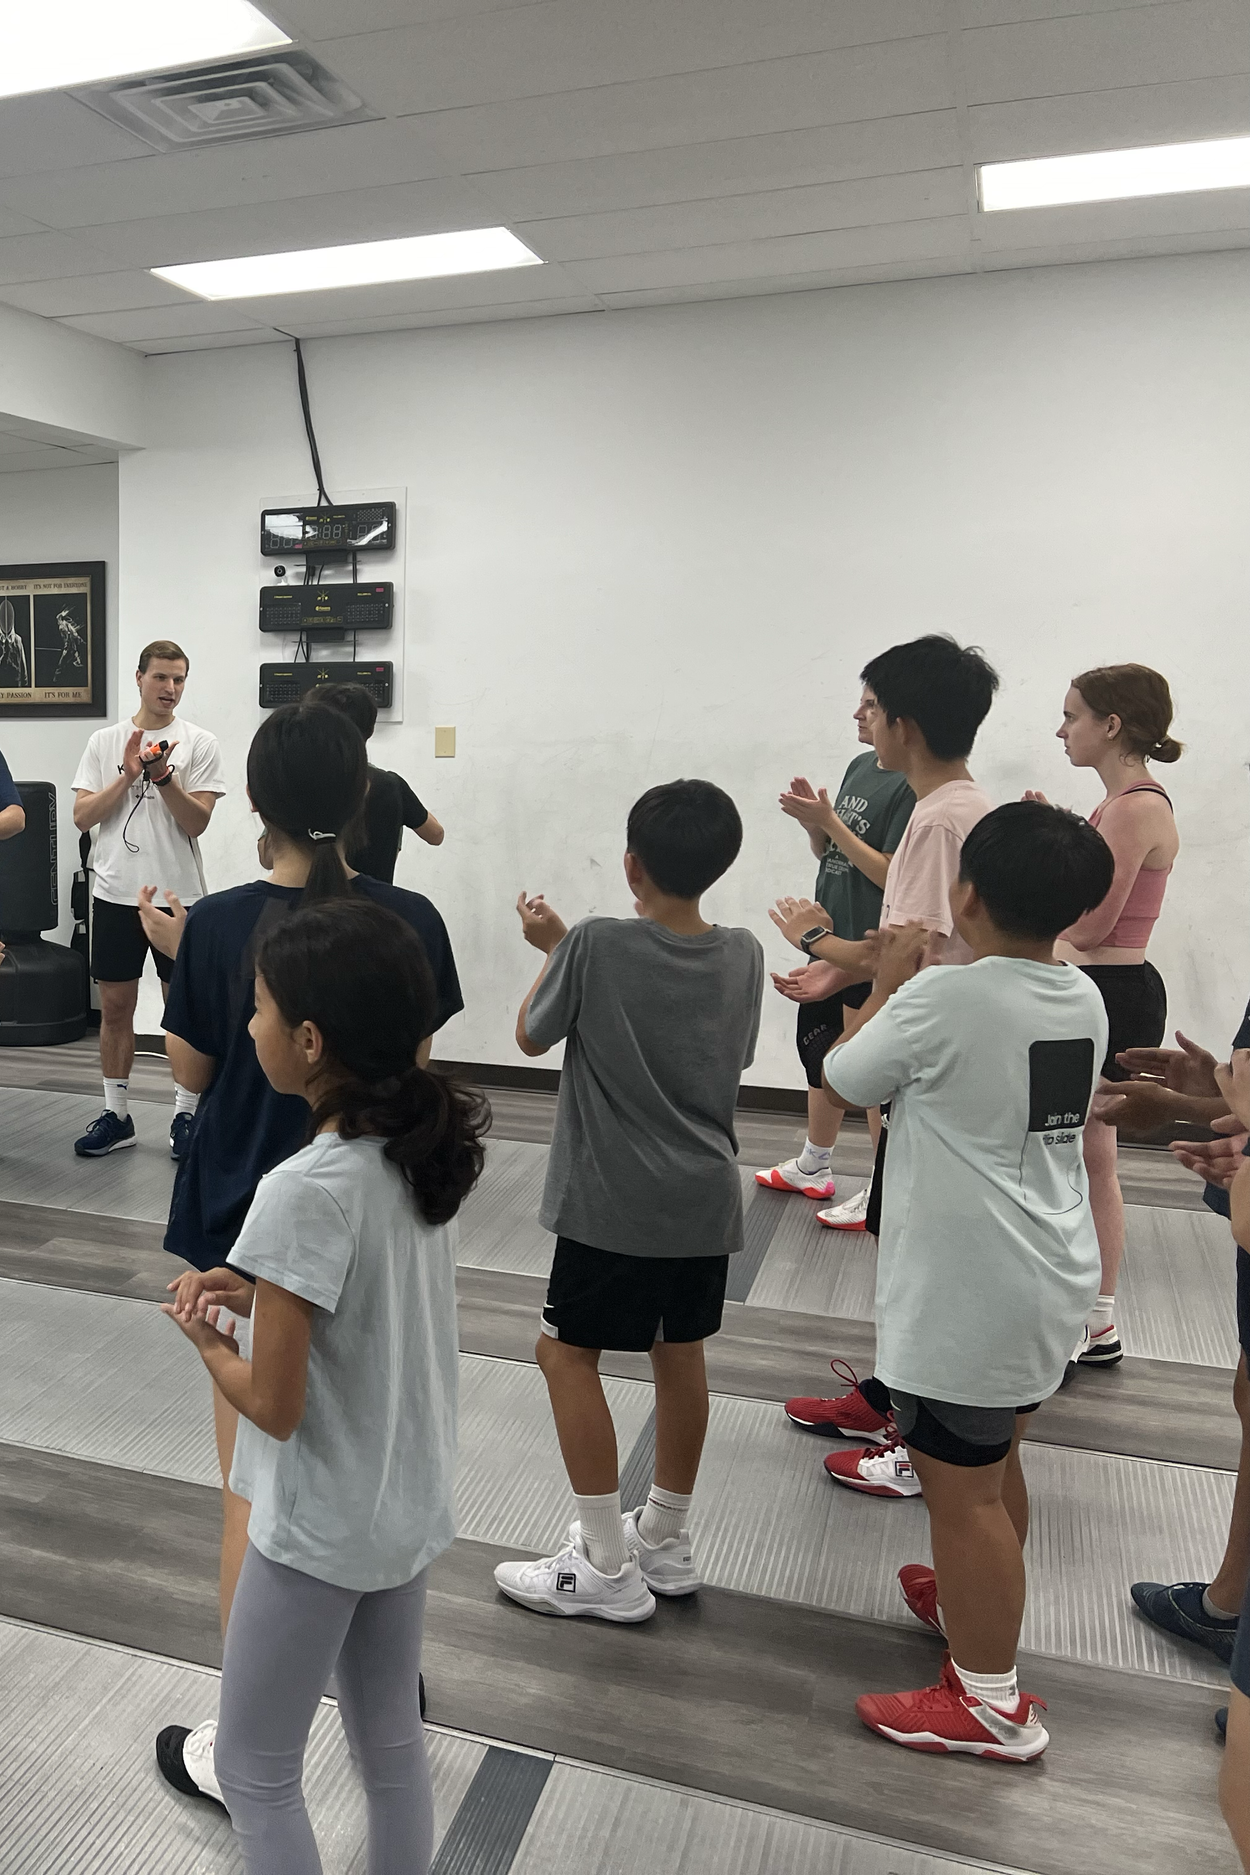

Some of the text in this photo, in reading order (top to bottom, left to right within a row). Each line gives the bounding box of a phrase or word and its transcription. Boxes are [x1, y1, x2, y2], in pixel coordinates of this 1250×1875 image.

[6, 691, 32, 699] PASSION
[44, 691, 56, 699] IT'S
[838, 795, 869, 813] AND
[836, 809, 871, 834] HAT'S
[803, 1024, 827, 1046] GEAR
[1063, 1111, 1080, 1124] the
[1055, 1131, 1076, 1145] side
